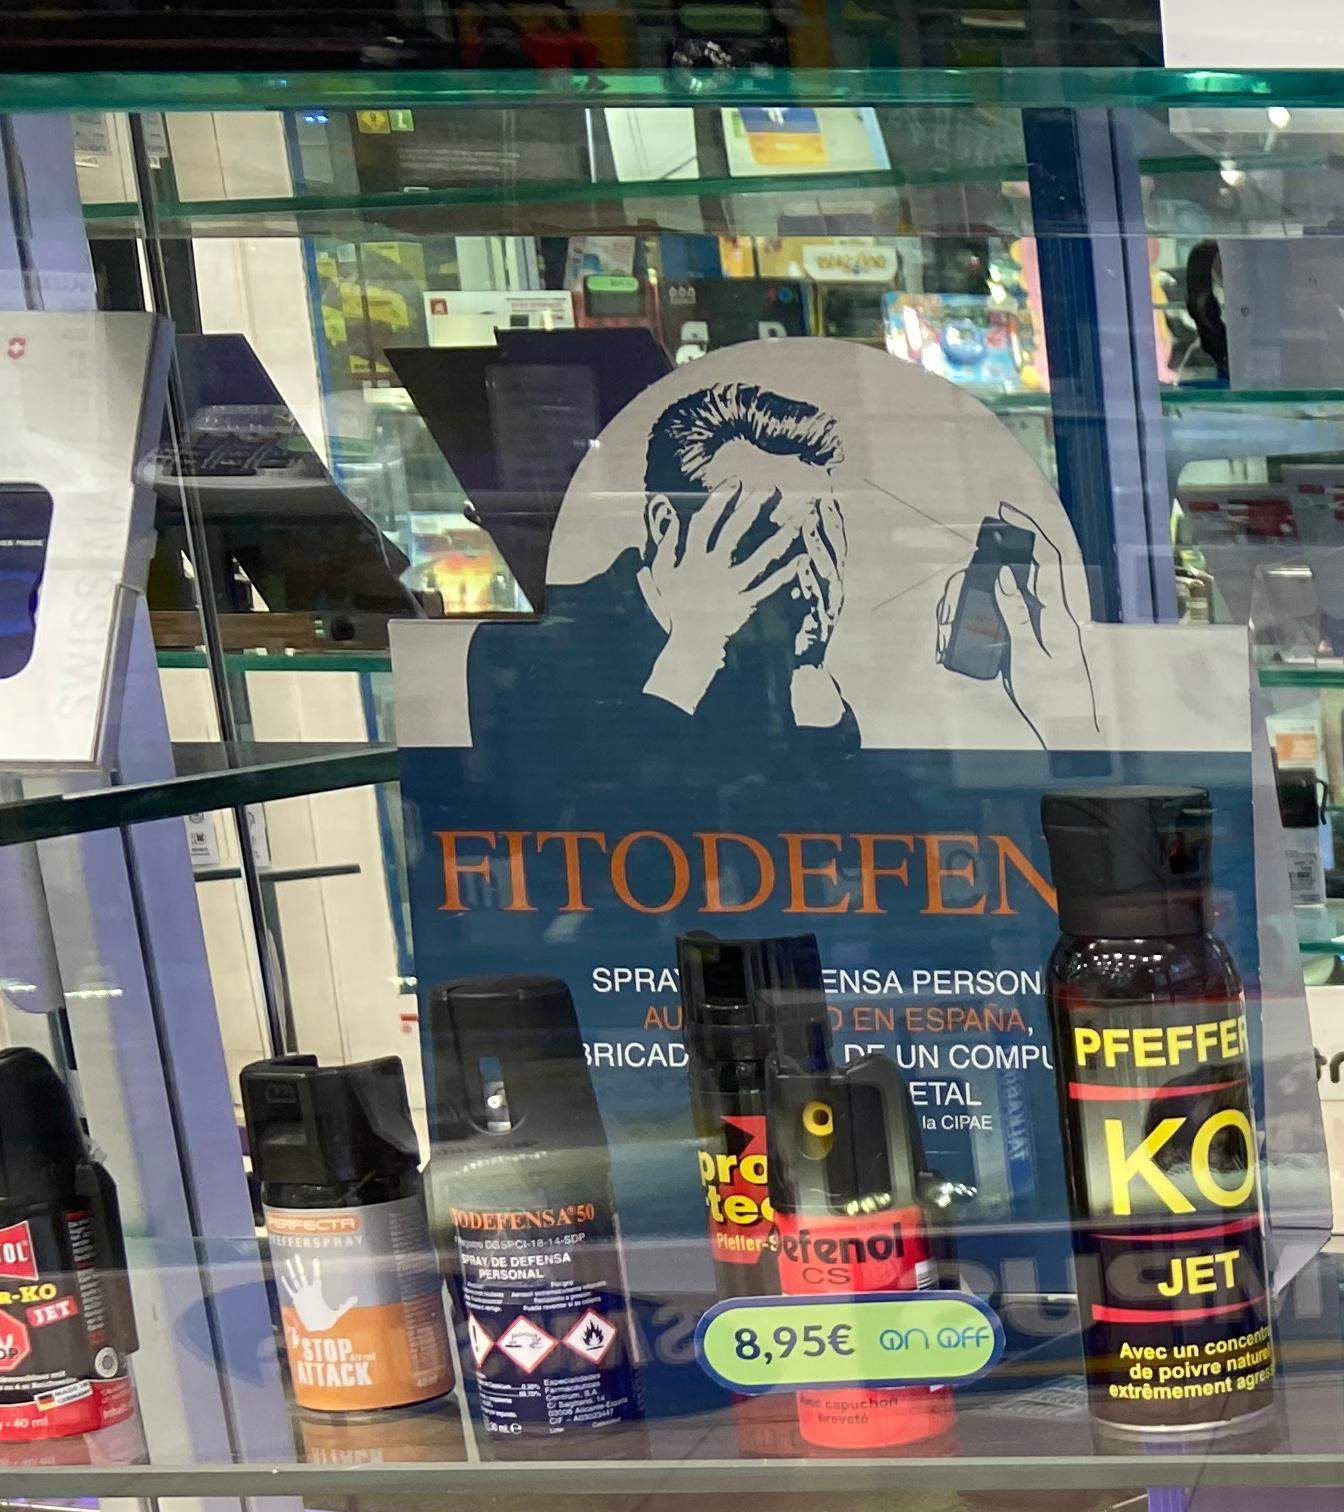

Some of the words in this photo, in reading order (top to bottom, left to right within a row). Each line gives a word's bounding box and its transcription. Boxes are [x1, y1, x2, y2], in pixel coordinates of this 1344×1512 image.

[433, 831, 1060, 915] FITODEFEN
[592, 967, 680, 993] SPRA
[821, 969, 904, 995] ENSA
[913, 969, 1046, 995] PERSON
[853, 1006, 893, 1032] EN
[905, 1003, 1033, 1034] ESPAÑA,
[897, 1045, 939, 1069] UN
[923, 1116, 936, 1130] la
[941, 1116, 993, 1131] CIPAE
[698, 1150, 768, 1186] pro
[1103, 1109, 1256, 1216] KO
[577, 1203, 595, 1222] 50
[491, 1254, 507, 1268] DE
[510, 1252, 571, 1268] DEFENSA
[479, 1268, 544, 1281] PERSONAL
[802, 1267, 850, 1285] CS
[1157, 1249, 1240, 1297] JET
[33, 1301, 71, 1324] JET
[301, 1337, 352, 1362] STOP
[734, 1323, 856, 1365] 8,95€
[1119, 1339, 1168, 1361] Avec
[1172, 1341, 1200, 1359] un
[297, 1360, 373, 1387] ATTACK
[1129, 1361, 1153, 1381] de
[1159, 1358, 1222, 1386] poivre
[1108, 1377, 1233, 1401] extrêmement
[826, 1397, 899, 1412] capuchon
